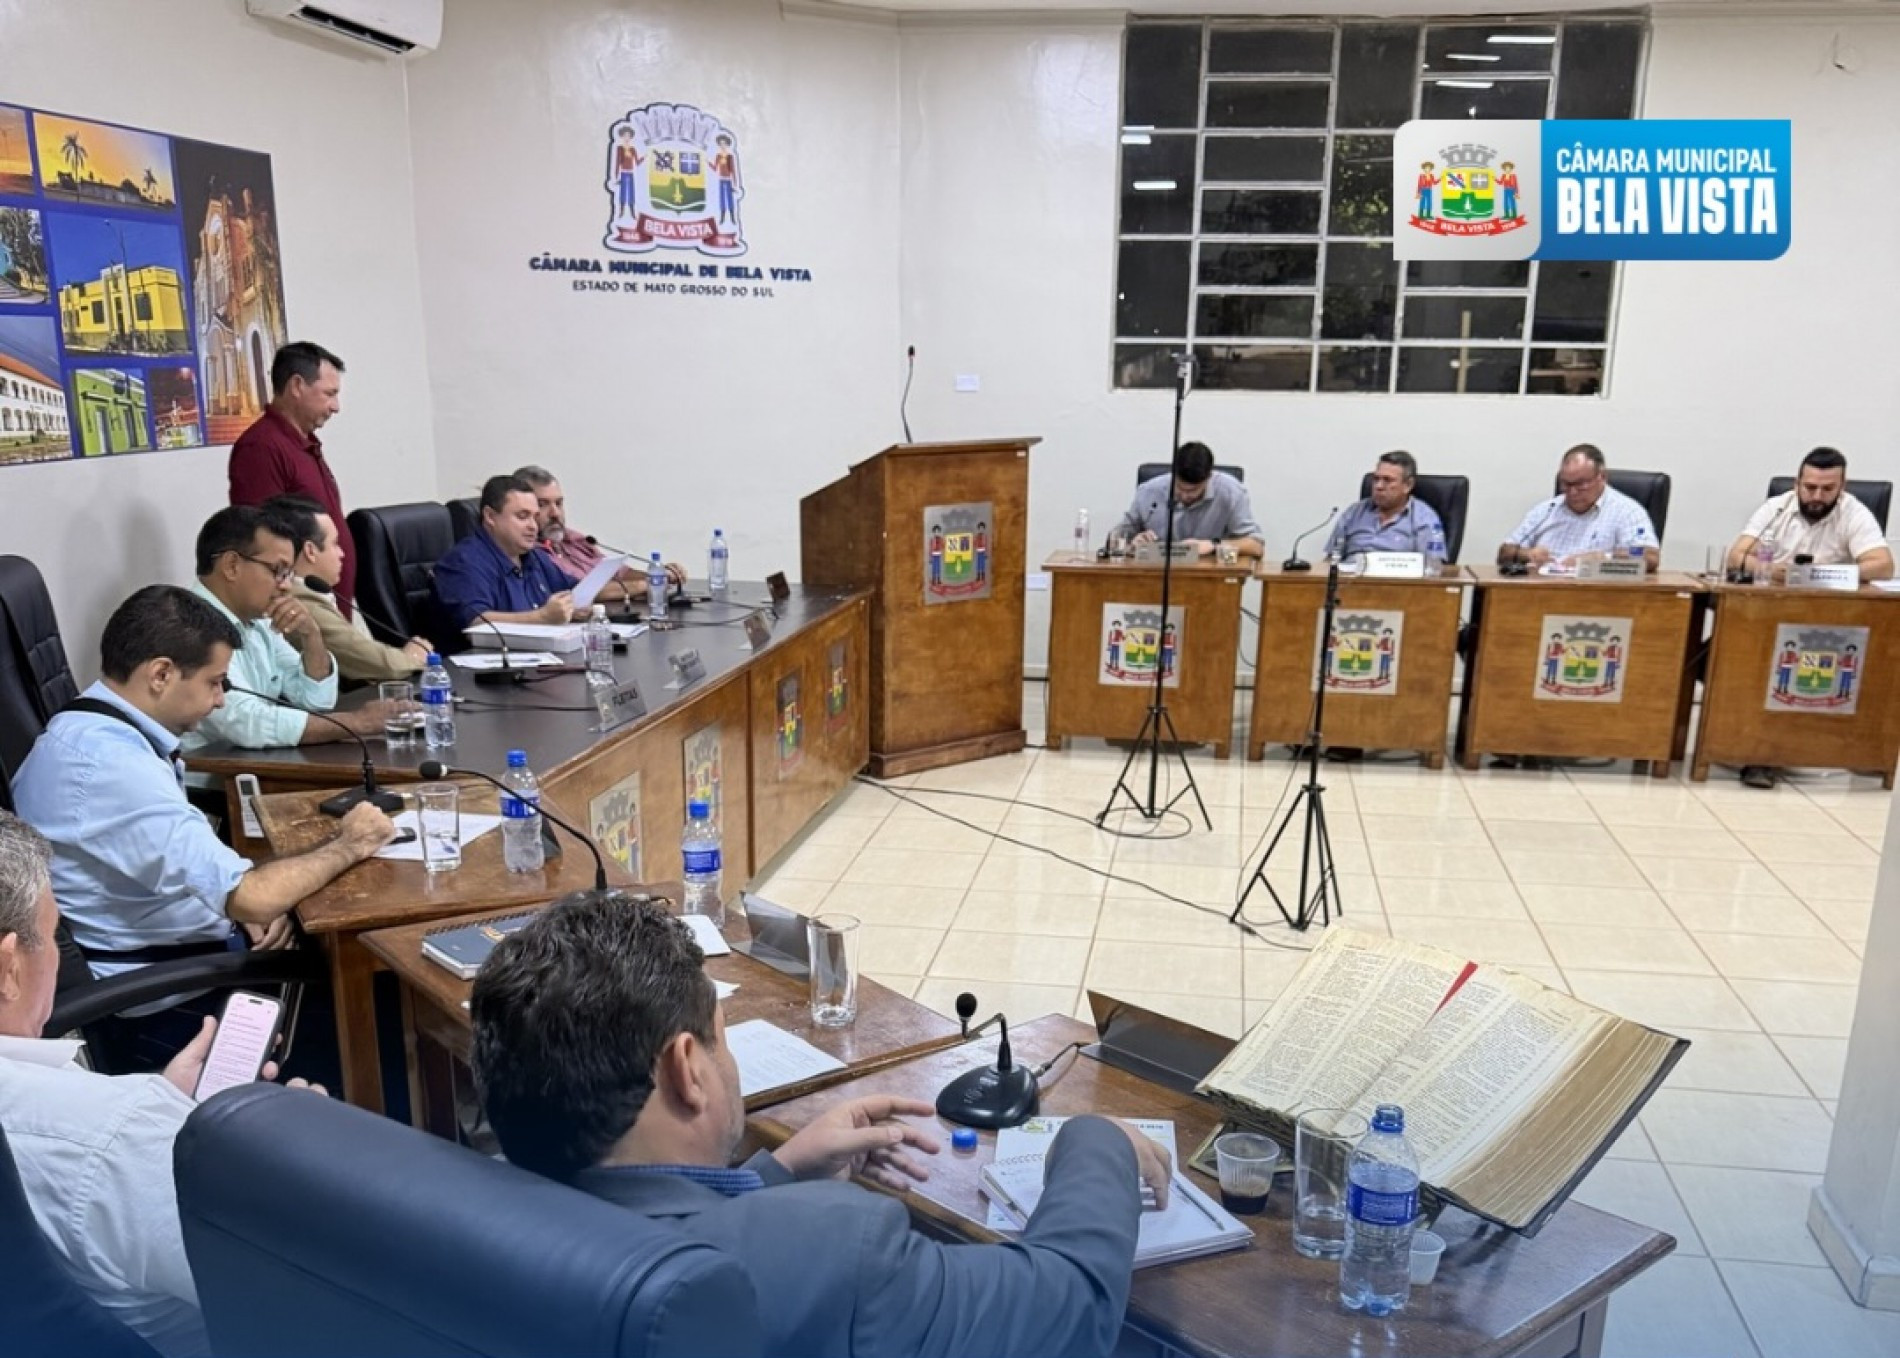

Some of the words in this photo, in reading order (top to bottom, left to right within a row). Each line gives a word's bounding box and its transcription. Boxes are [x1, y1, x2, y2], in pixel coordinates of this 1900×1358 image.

[645, 219, 676, 236] BELA
[678, 221, 713, 237] VISTA
[529, 252, 603, 274] CÂMARA
[609, 260, 693, 277] MUNICIPAL
[700, 264, 719, 278] DE
[725, 265, 763, 280] BELA
[769, 267, 812, 282] VISTA
[572, 280, 620, 293] ESTADO
[624, 282, 639, 293] DE
[644, 283, 677, 295] MATO
[680, 284, 727, 297] GROSSO
[731, 286, 749, 298] DO
[753, 287, 775, 299] SUL
